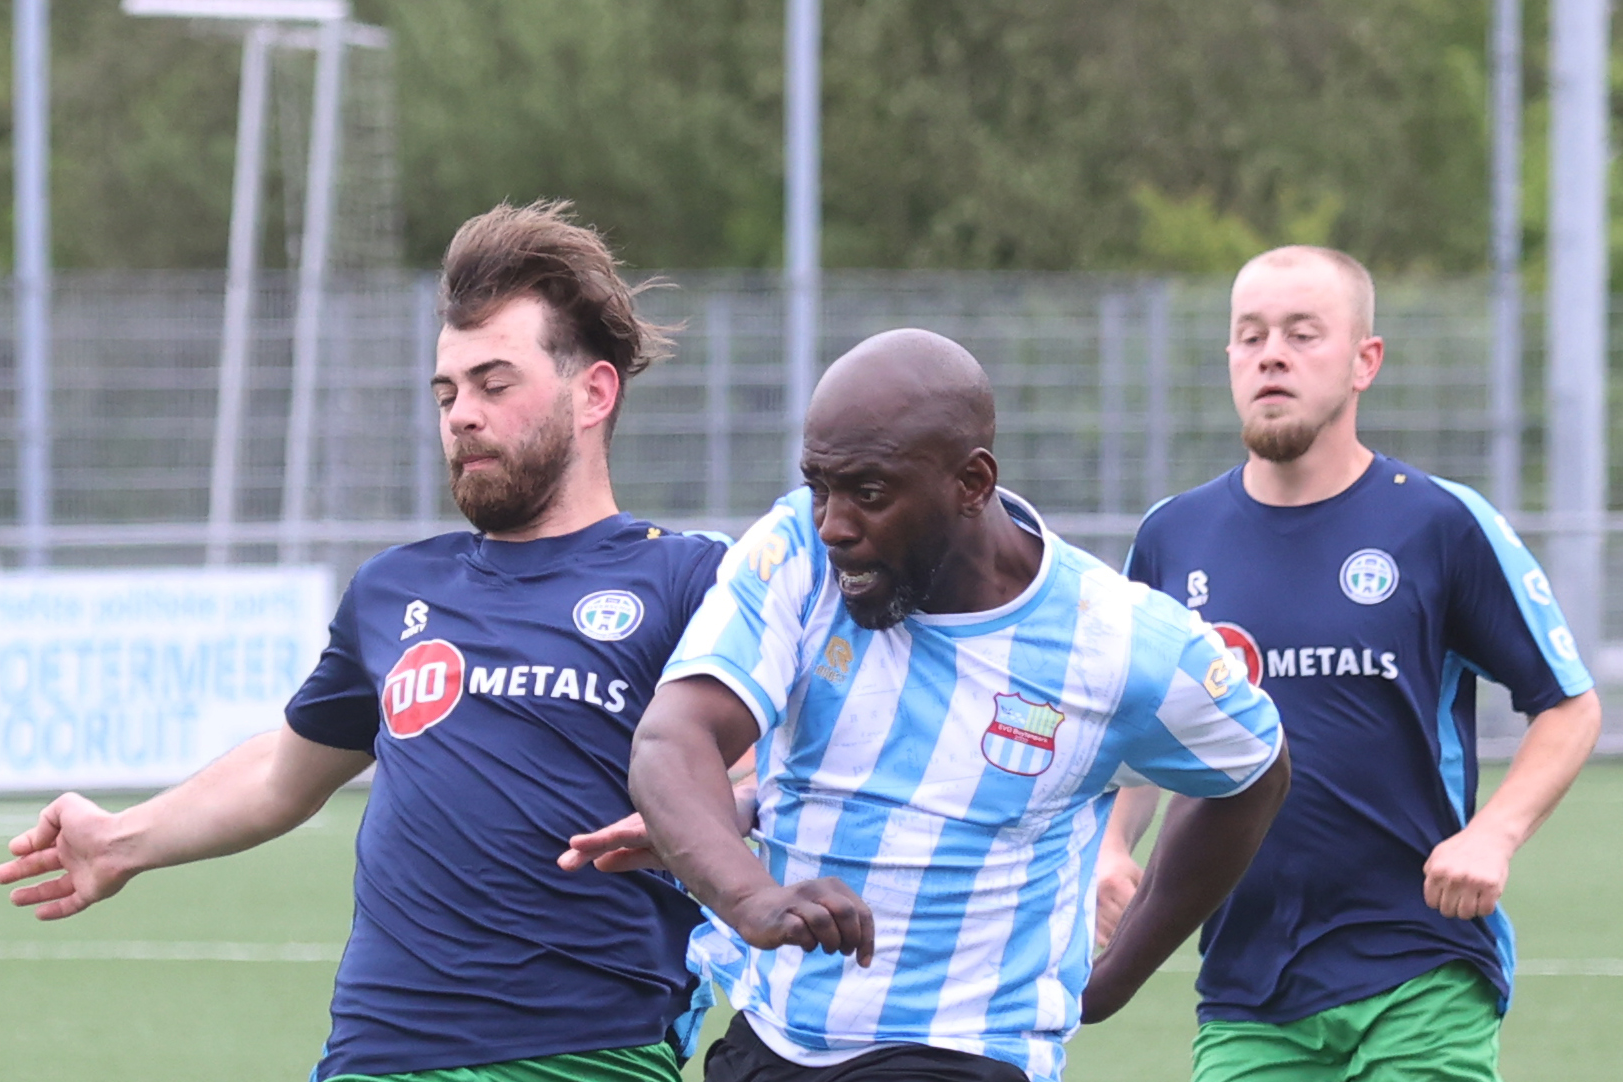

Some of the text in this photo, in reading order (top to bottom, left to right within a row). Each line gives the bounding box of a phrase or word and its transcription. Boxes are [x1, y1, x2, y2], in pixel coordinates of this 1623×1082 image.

[1267, 647, 1399, 680] METALS
[388, 661, 629, 716] DO METALS
